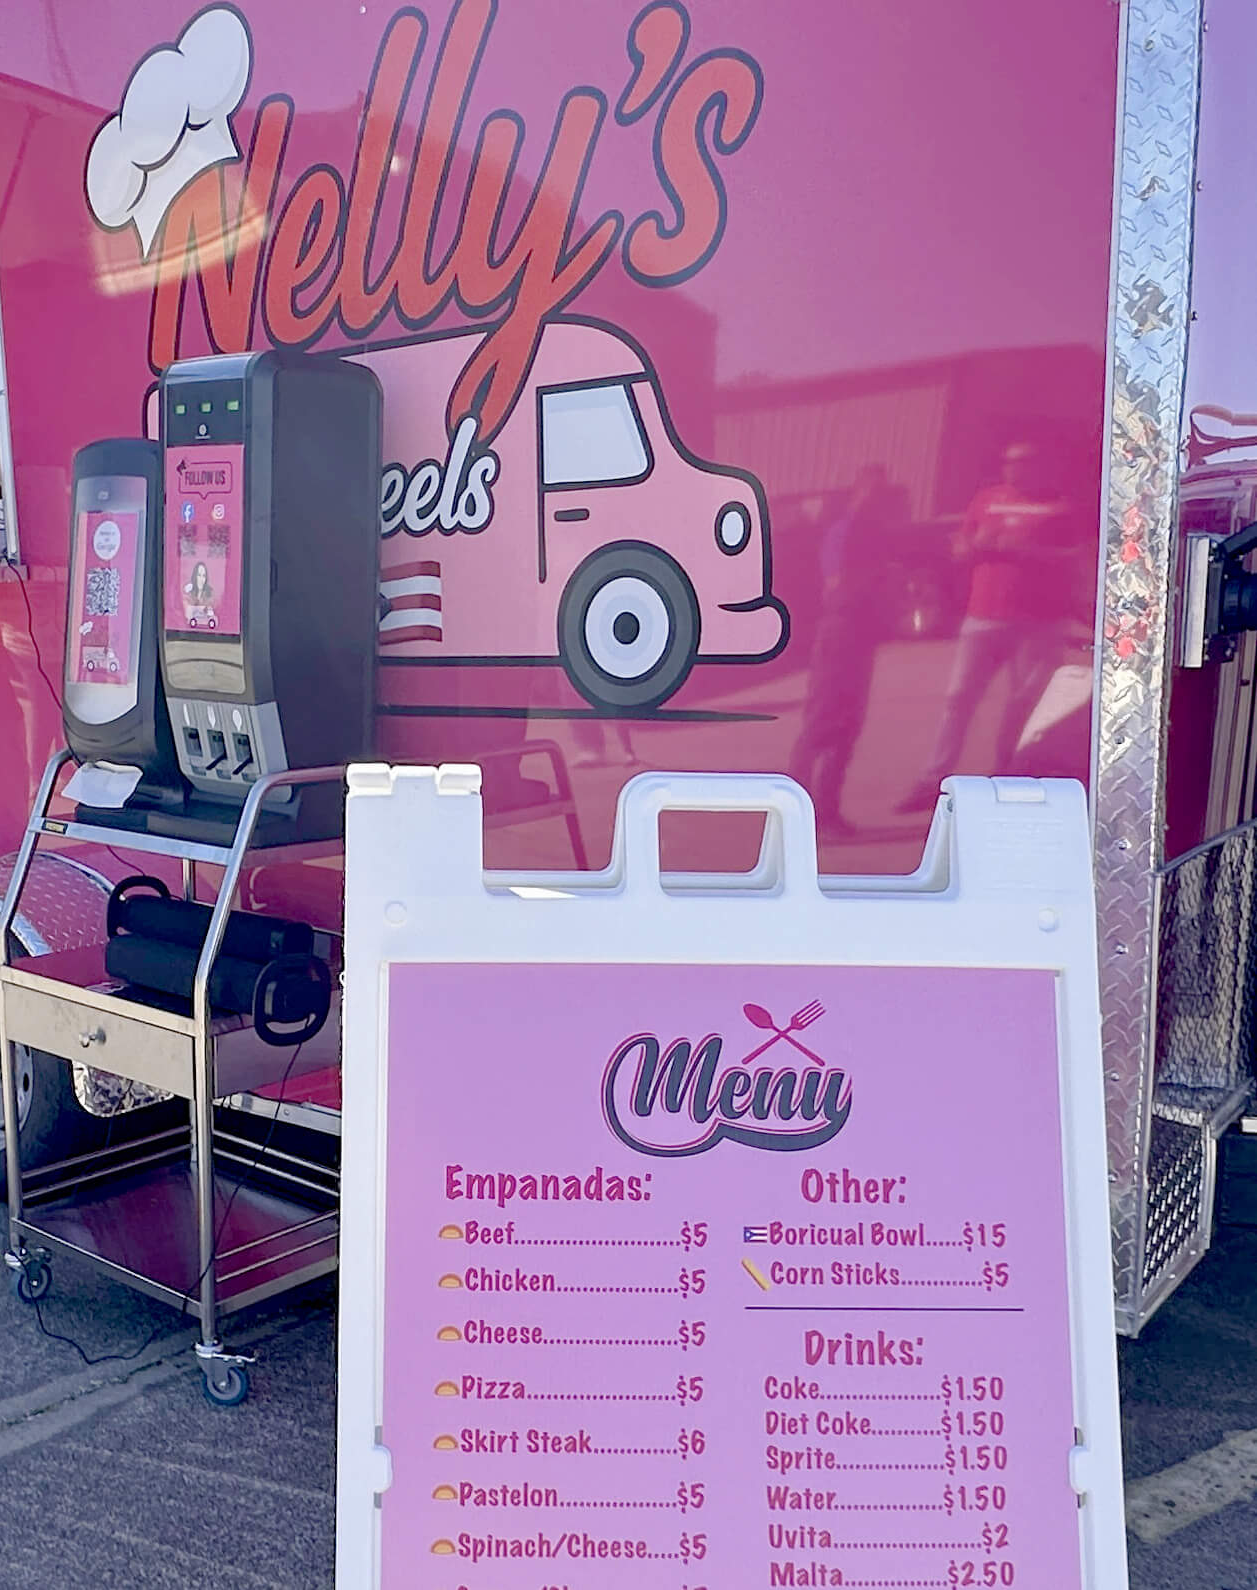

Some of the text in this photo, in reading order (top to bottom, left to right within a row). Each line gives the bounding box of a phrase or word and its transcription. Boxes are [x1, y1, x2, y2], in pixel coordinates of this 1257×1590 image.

[147, 0, 764, 447] Nelly's
[184, 470, 225, 485] FOLLOW US
[600, 1031, 852, 1158] Menu
[446, 1164, 652, 1209] Empanadas:
[801, 1167, 907, 1204] Other:
[465, 1220, 708, 1253] Beef $5
[769, 1221, 1006, 1253] Boricual Bowl $15
[465, 1267, 706, 1299] Chicken $5
[770, 1260, 1009, 1292] Corn Sticks $5
[463, 1319, 706, 1352] Cheese $5
[804, 1329, 924, 1366] Drinks:
[462, 1375, 704, 1407] Pizza $5
[764, 1374, 1004, 1407] Coke $1.50
[764, 1409, 1004, 1441] Diet Coke $1.50
[460, 1428, 705, 1461] Skirt Steak $6
[766, 1443, 1008, 1476] Sprite $1.50
[459, 1481, 705, 1514] Pastelon $5
[766, 1484, 1006, 1517] Water $1.50
[458, 1532, 707, 1565] Spinach/Cheese $5
[768, 1521, 1009, 1555] Uvita $2
[770, 1559, 1014, 1590] Malta $2.50
